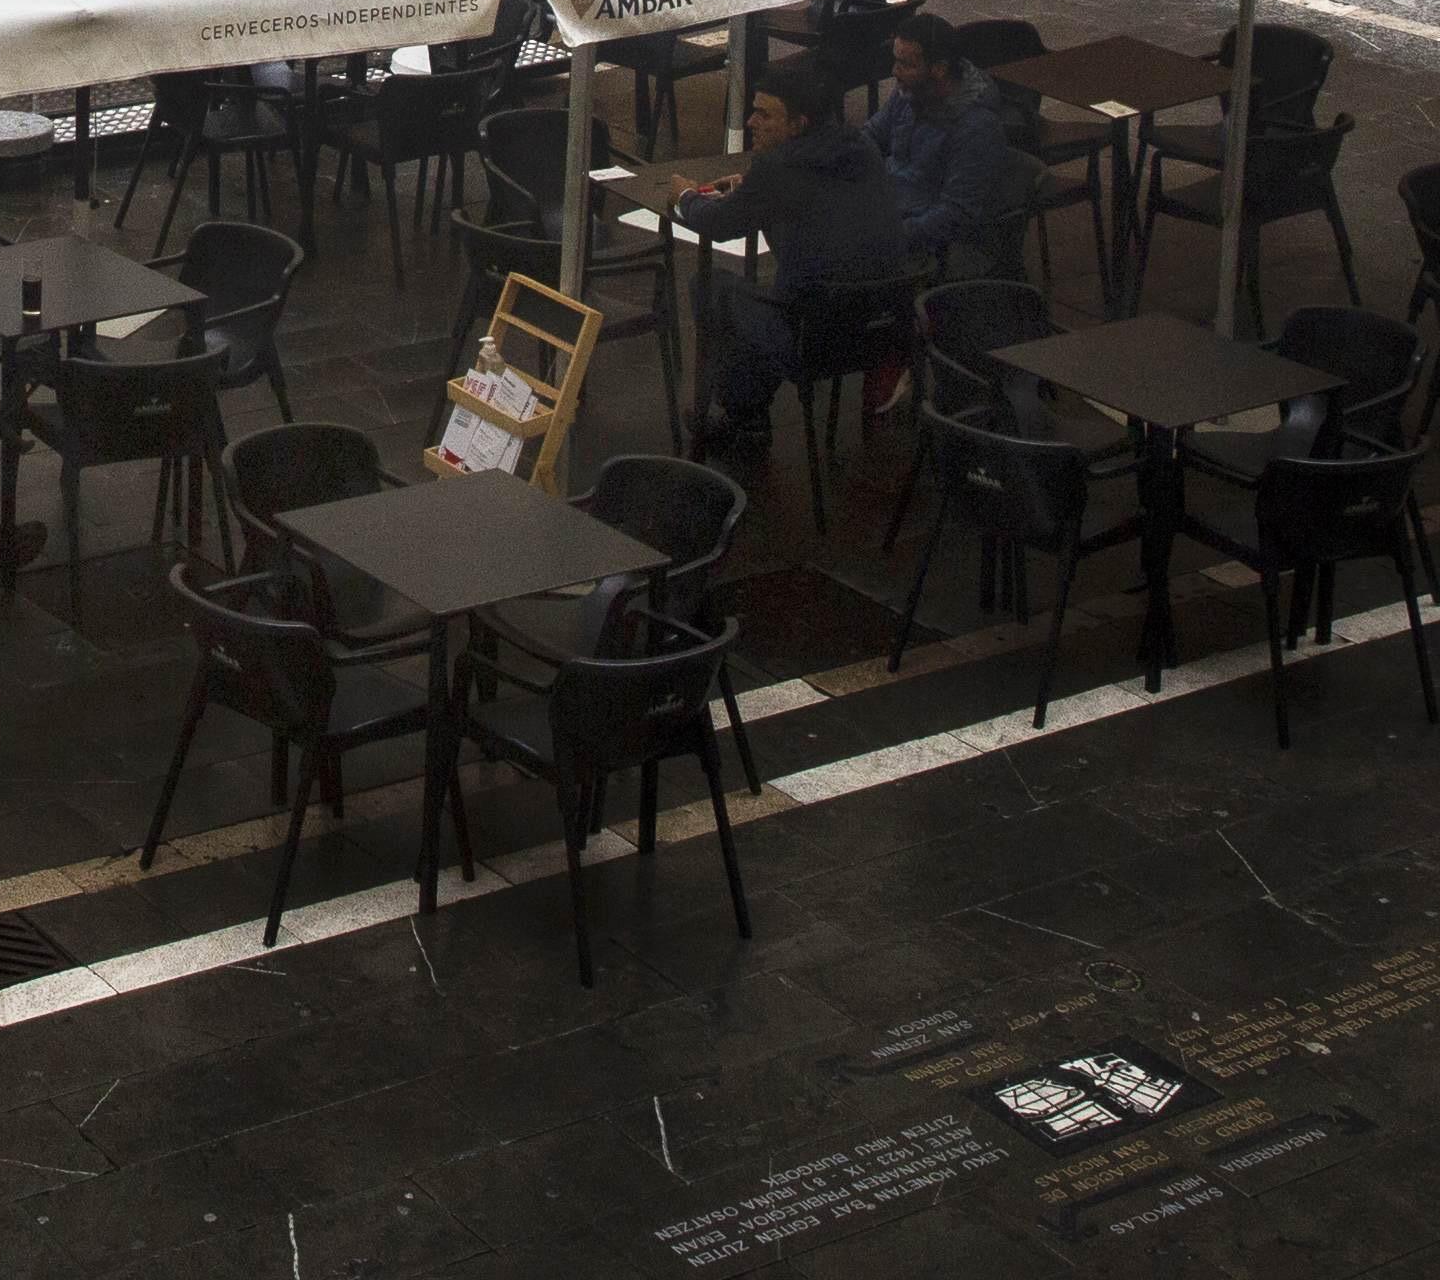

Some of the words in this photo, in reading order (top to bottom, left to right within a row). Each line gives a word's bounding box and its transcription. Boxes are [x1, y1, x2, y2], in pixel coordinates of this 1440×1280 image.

[200, 13, 319, 41] CERVECEROS
[886, 1008, 959, 1038] BURGOA
[936, 1019, 974, 1038] SAN
[869, 1033, 930, 1060] ZERNIN
[901, 1113, 957, 1139] ZUTEN
[927, 1124, 974, 1149] ARTE
[853, 1134, 897, 1156] HIRU
[961, 1147, 1010, 1170] LEKU
[1218, 1127, 1328, 1174] NABARRERIA
[760, 1152, 849, 1188] BURGOEK
[873, 1168, 957, 1203] HONETAN
[1159, 1174, 1207, 1197] HIRIA
[1183, 1186, 1225, 1206] SAN
[829, 1196, 866, 1219] BAT
[1108, 1200, 1186, 1236] NIKOLAS
[653, 1205, 736, 1241] OSATZEN
[754, 1214, 821, 1244] EGITEN
[670, 1229, 724, 1256] EMAN
[687, 1239, 750, 1268] ZUTEN
